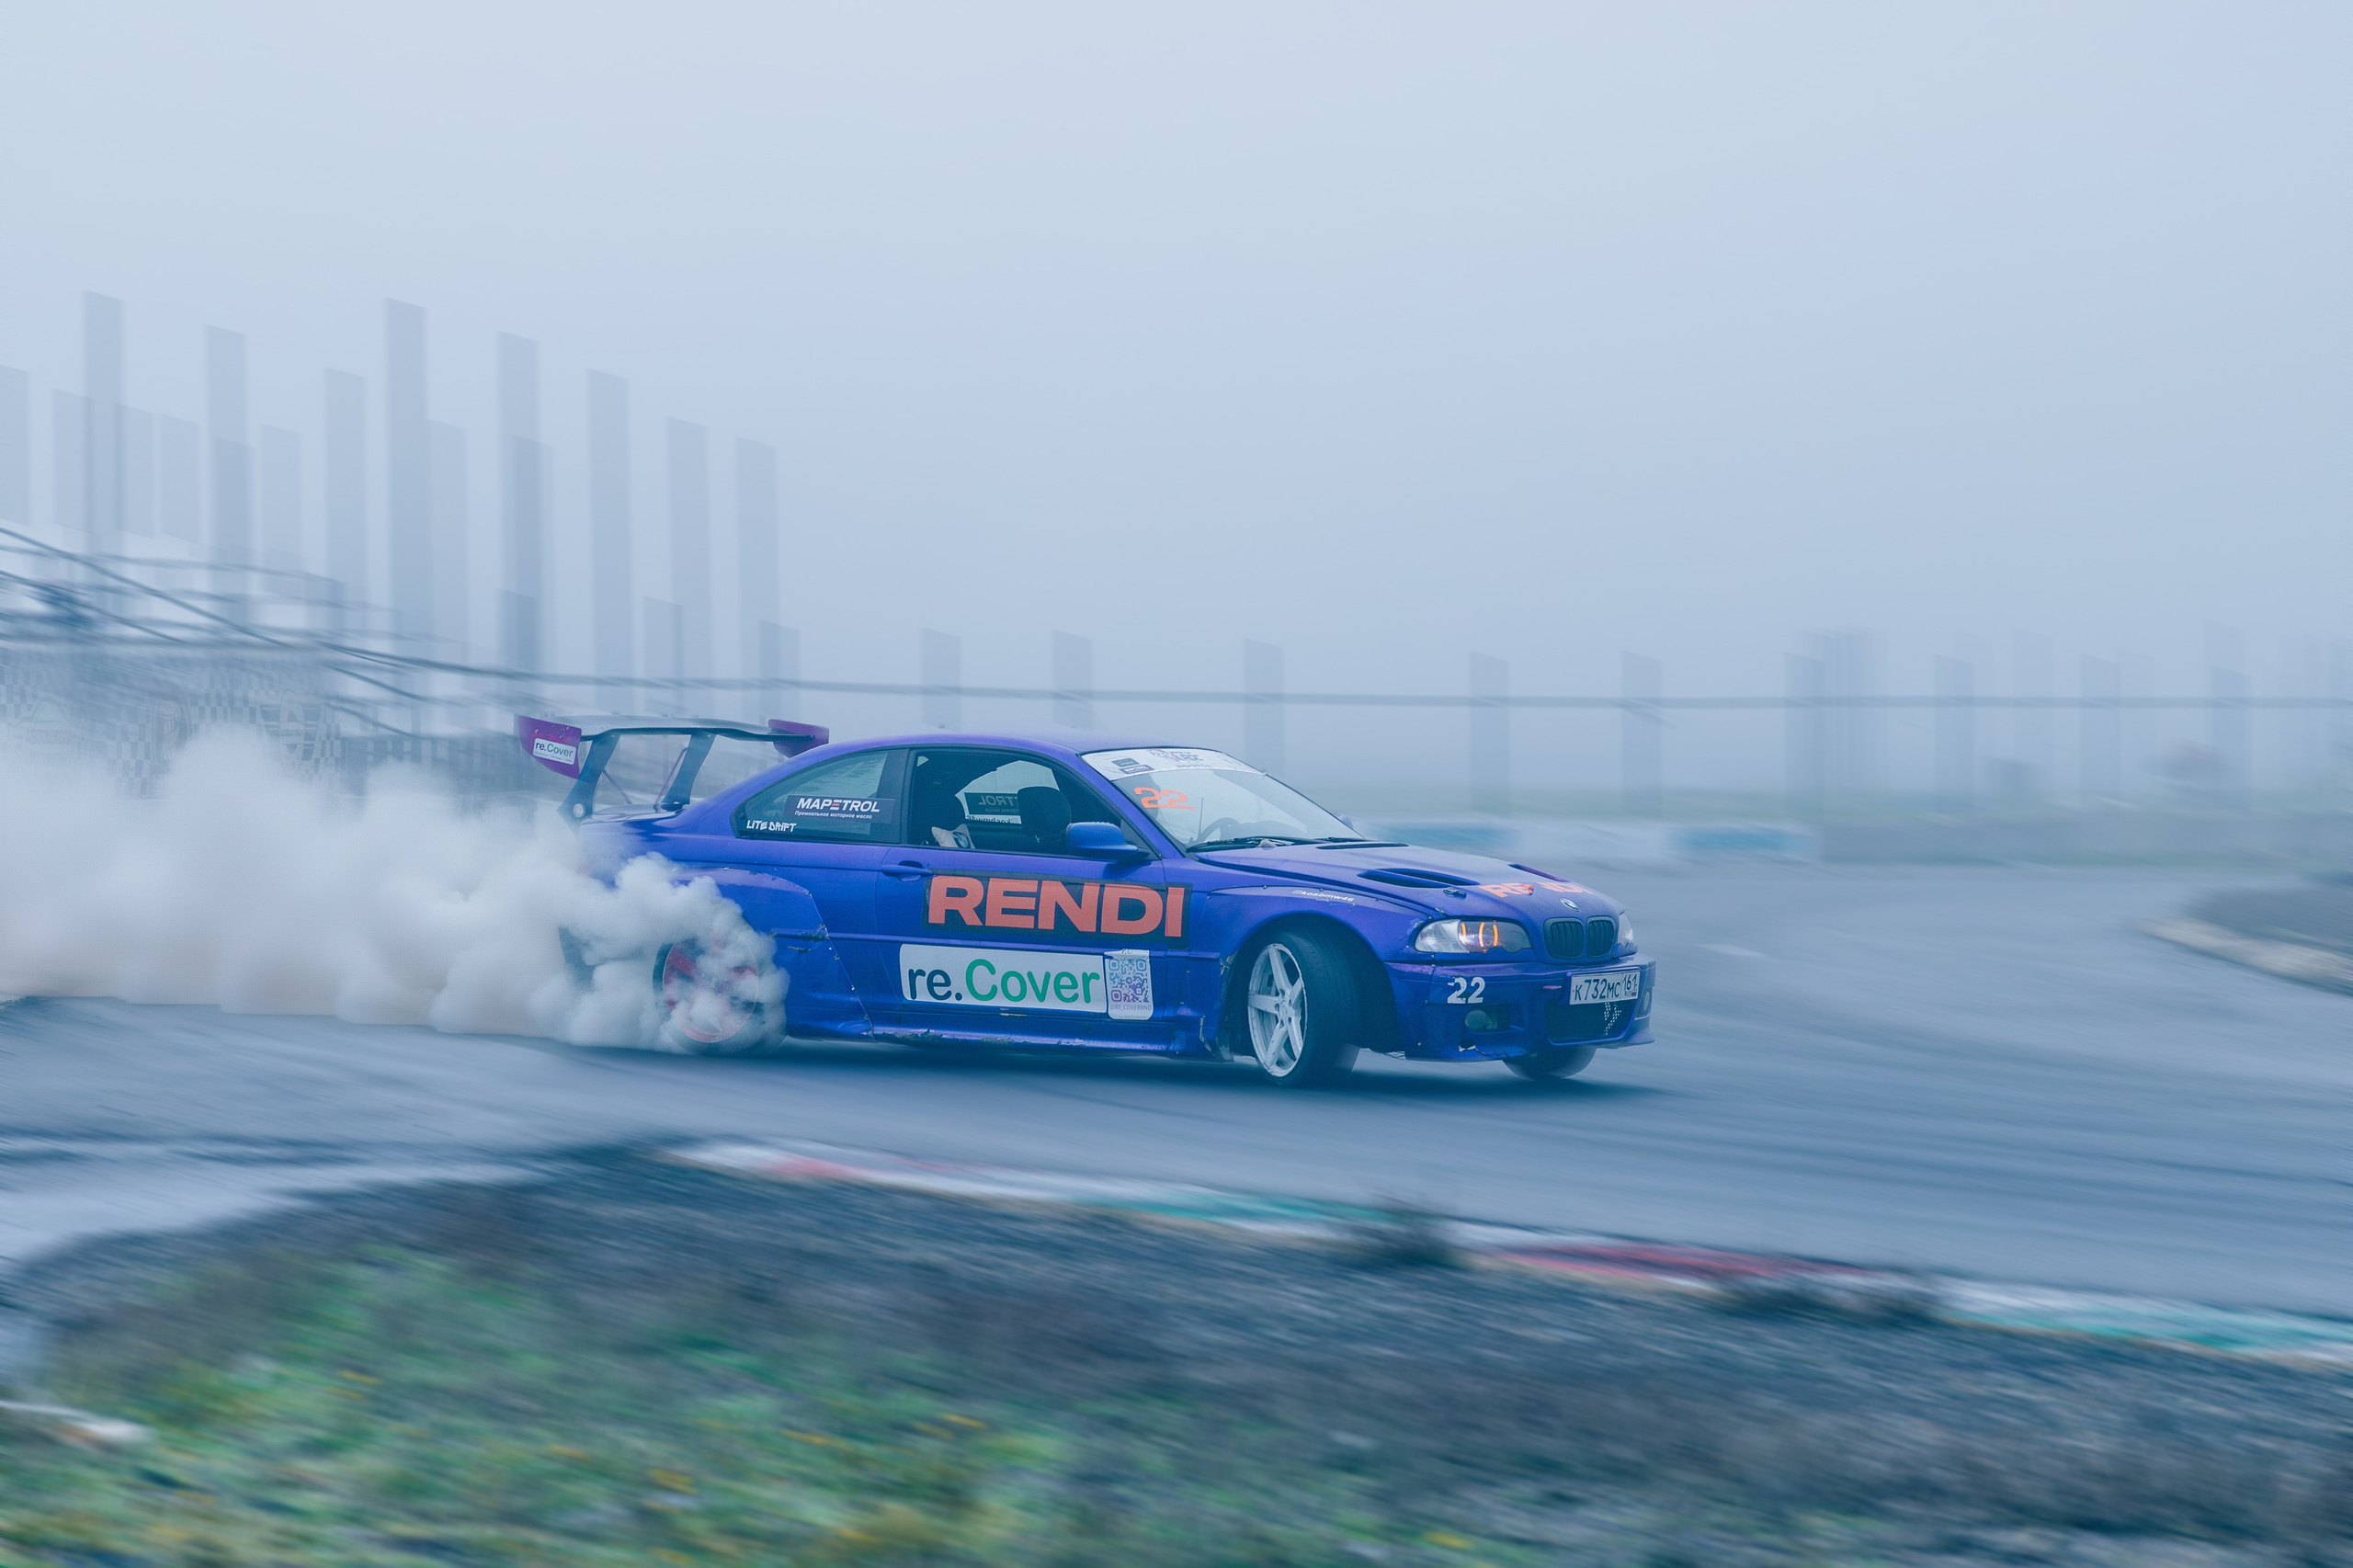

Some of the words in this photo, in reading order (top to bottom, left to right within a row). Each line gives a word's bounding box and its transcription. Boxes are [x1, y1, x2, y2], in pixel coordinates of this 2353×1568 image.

[535, 742, 574, 757] re.Cover
[796, 798, 881, 812] MAPETROL
[1133, 787, 1196, 811] 22
[746, 820, 767, 831] LITE
[768, 821, 797, 833] DRIFT
[927, 874, 1186, 938] RENDI
[907, 958, 1100, 1005] re.Cover
[1447, 976, 1485, 1005] 22
[1622, 974, 1637, 991] 161
